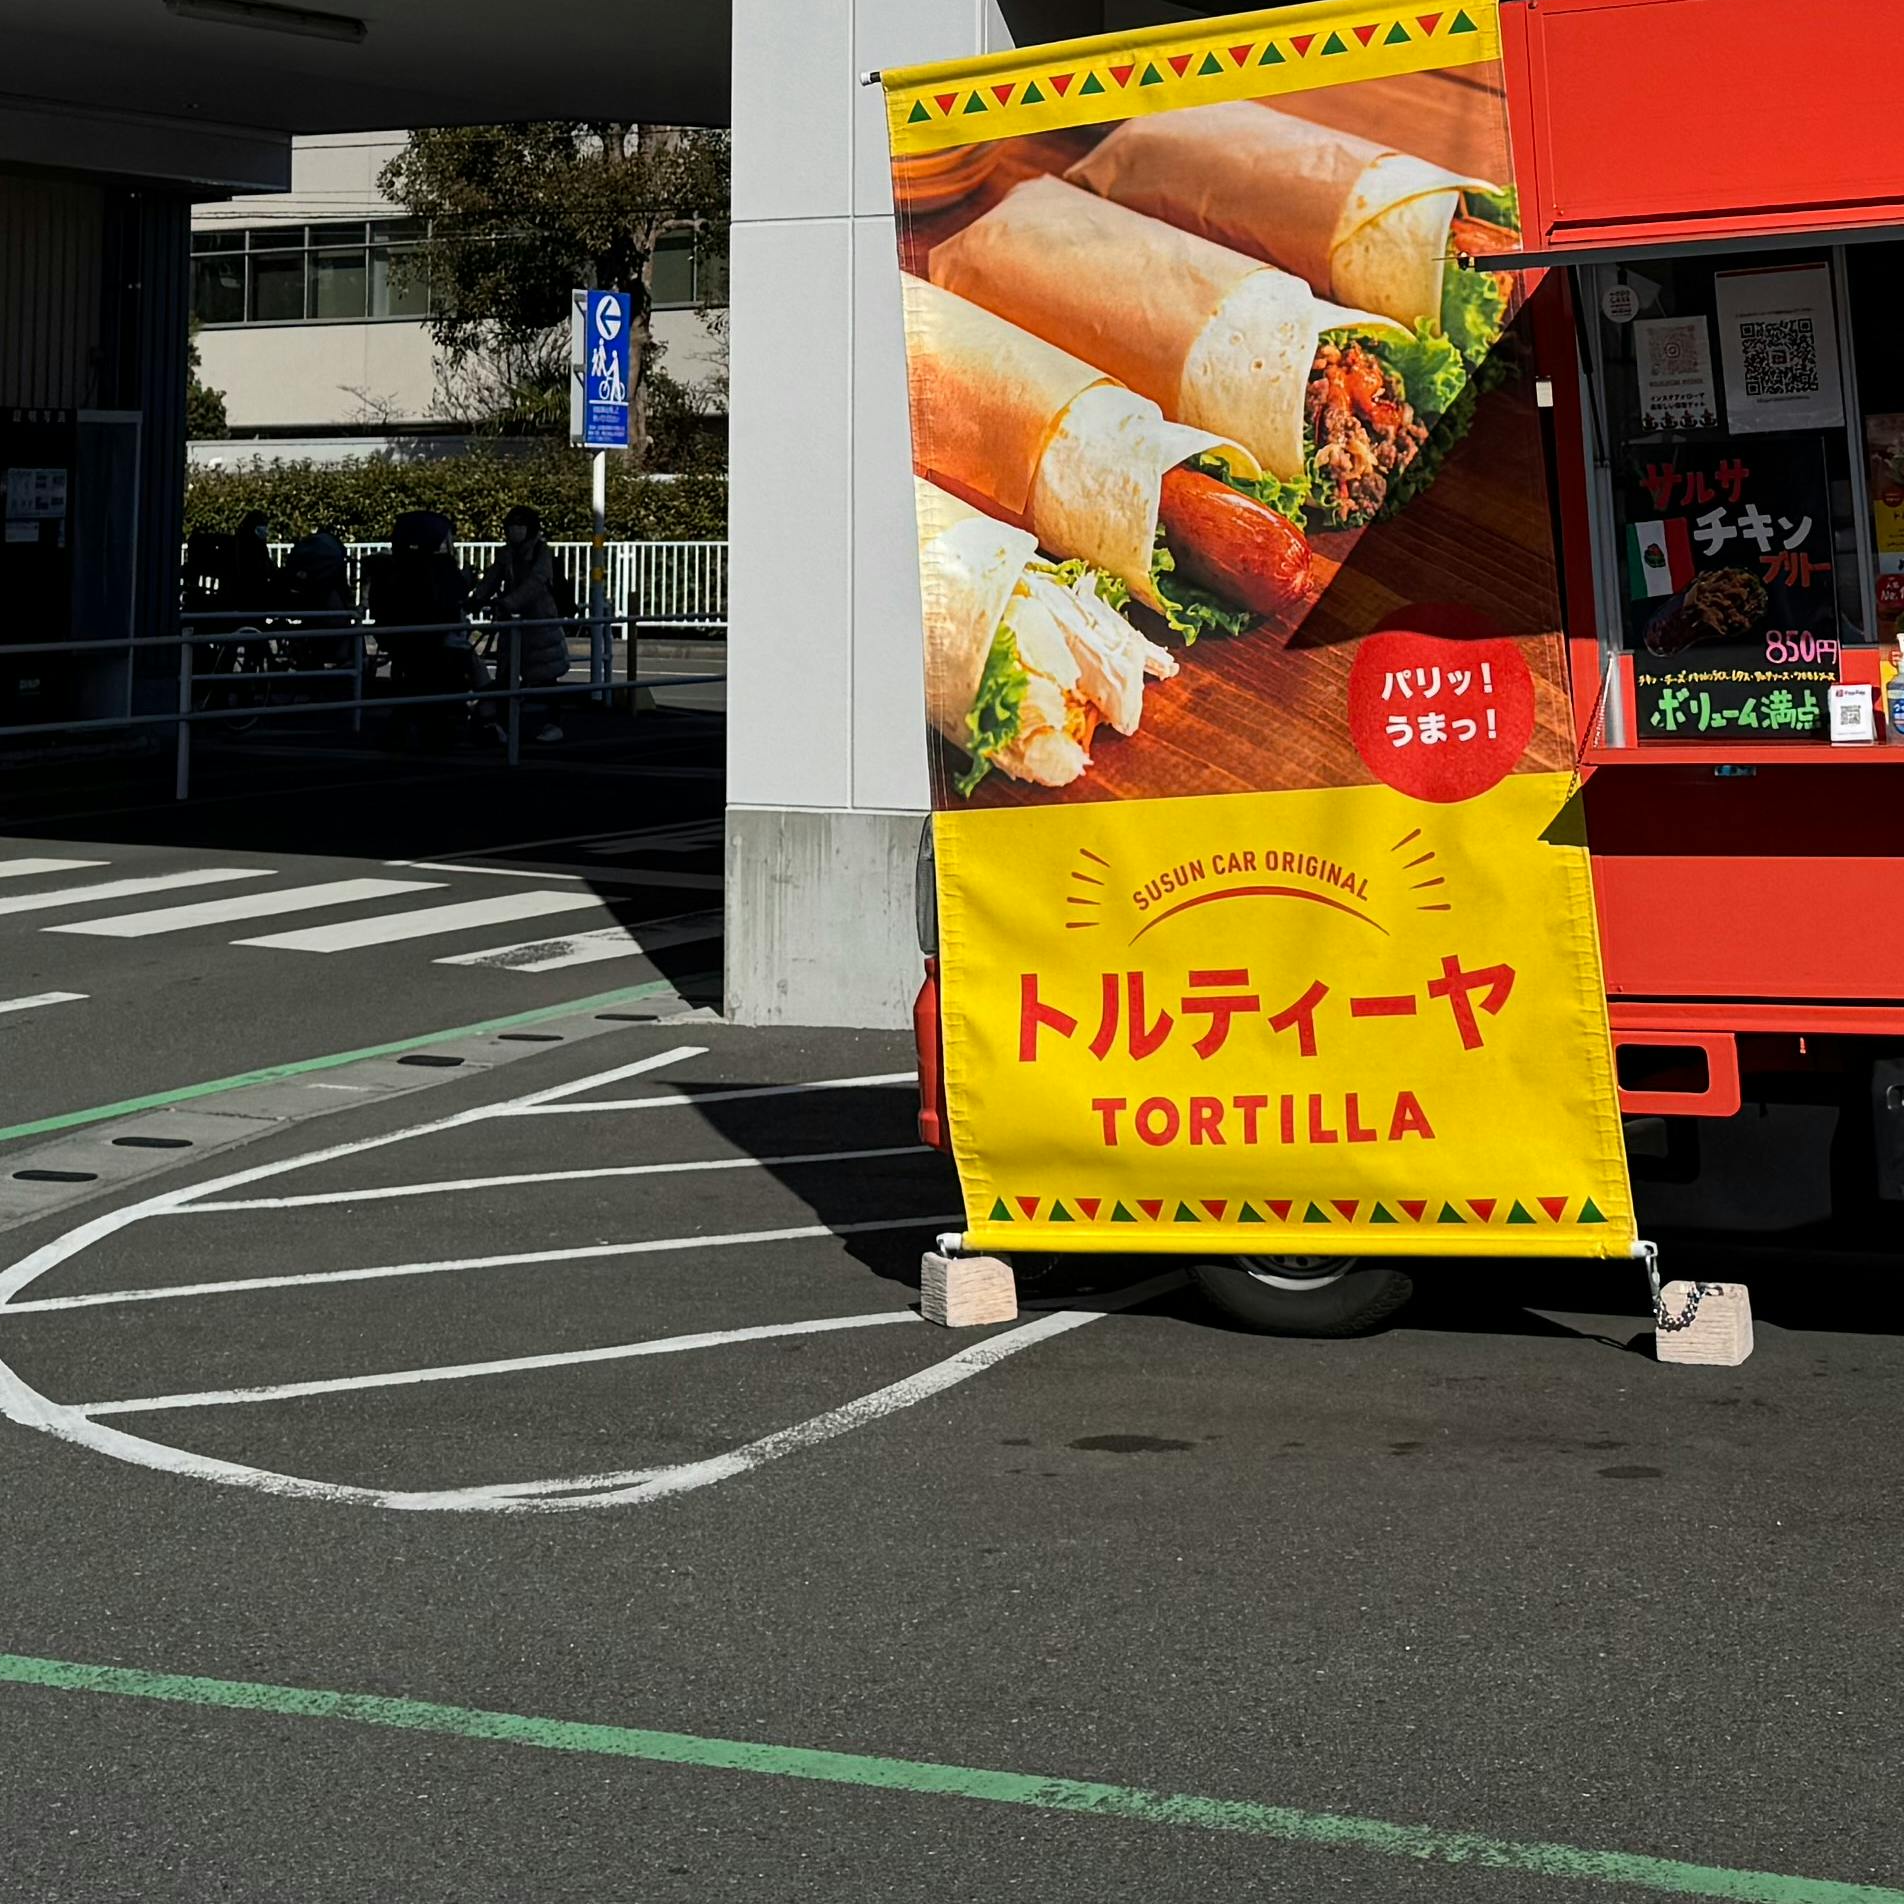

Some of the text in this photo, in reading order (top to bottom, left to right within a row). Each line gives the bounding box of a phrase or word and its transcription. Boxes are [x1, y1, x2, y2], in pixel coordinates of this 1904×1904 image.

[1640, 459, 1750, 510] サルサ
[1694, 504, 1812, 556] チキン
[1766, 630, 1838, 664] 850円
[1382, 662, 1494, 699] パリッ!
[1385, 707, 1497, 747] うまっ!
[1651, 688, 1821, 731] ボリューム満点
[1133, 851, 1370, 911] SUSUN CAR ORIGINAL
[1018, 954, 1517, 1063] トルティーヤ
[1092, 1090, 1435, 1147] TORTILLA
